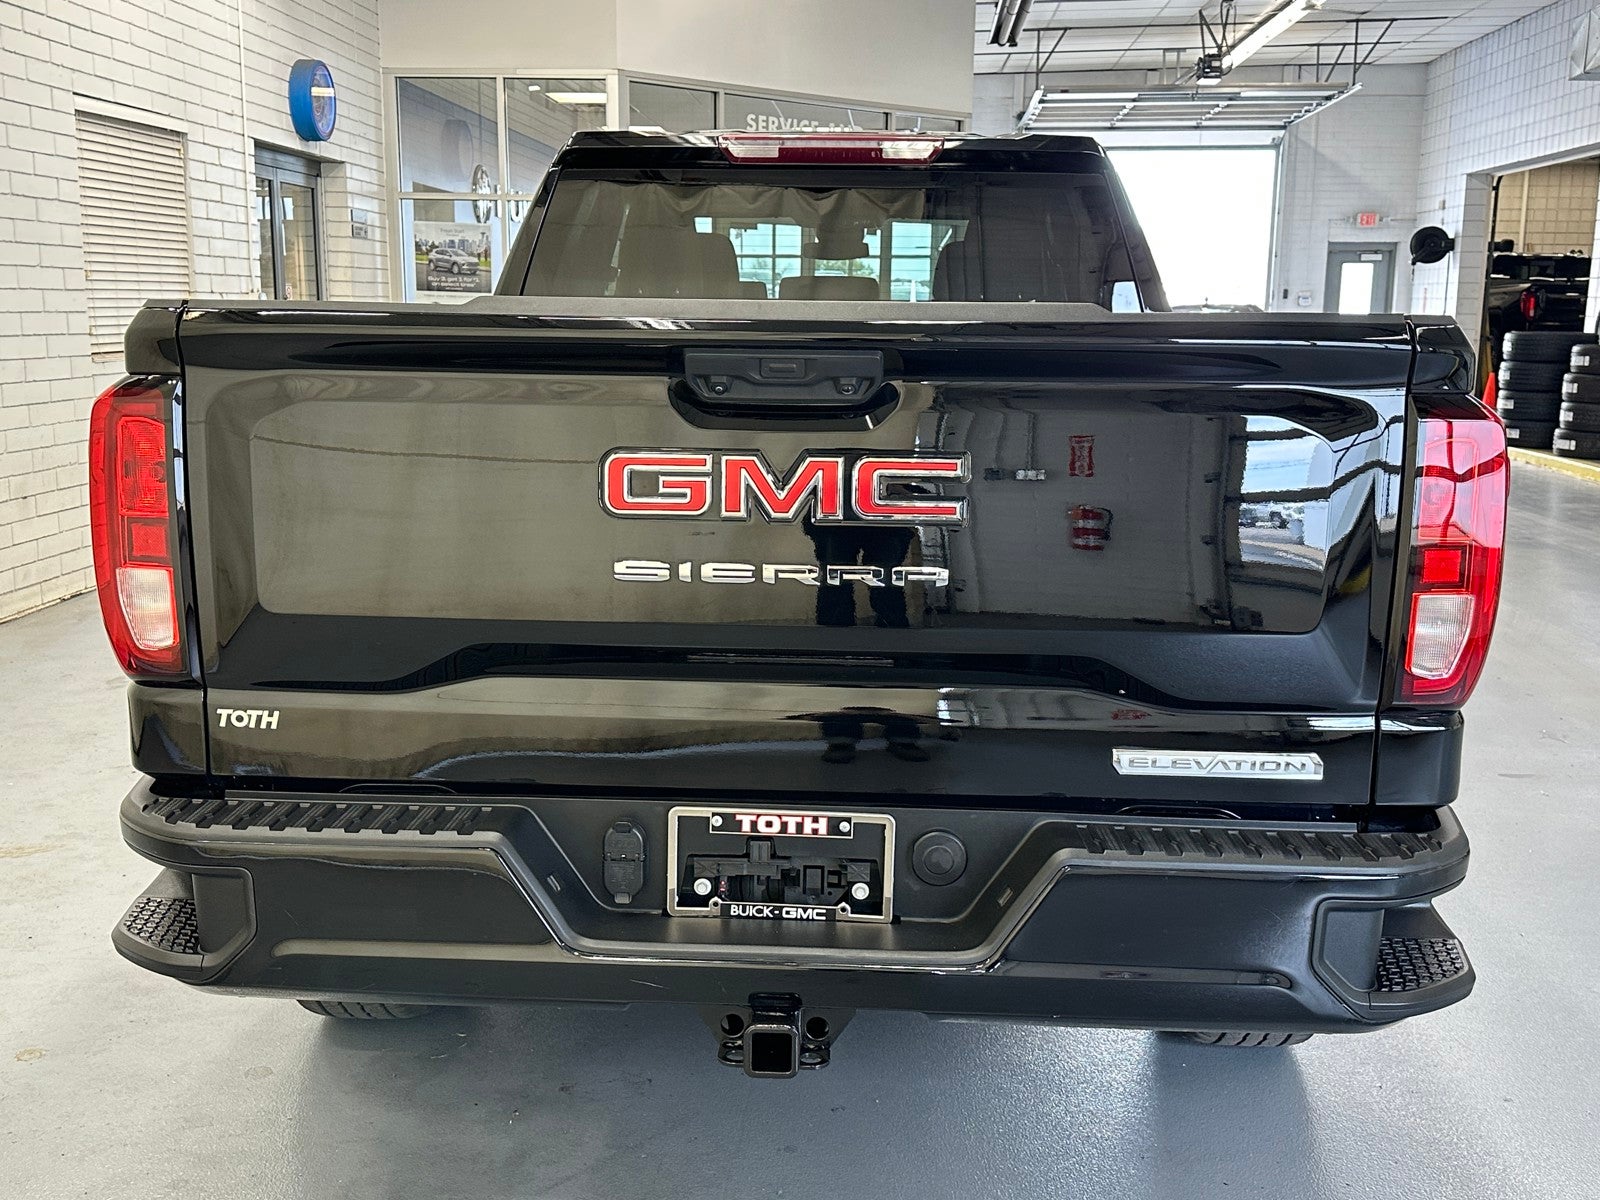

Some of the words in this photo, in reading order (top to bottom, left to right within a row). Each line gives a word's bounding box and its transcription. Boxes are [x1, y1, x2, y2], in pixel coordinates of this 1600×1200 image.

[601, 448, 970, 525] GMC
[612, 559, 951, 588] SIERRA
[216, 708, 280, 730] TOTH
[1128, 755, 1307, 774] ELEVATION
[735, 813, 829, 835] TOTH
